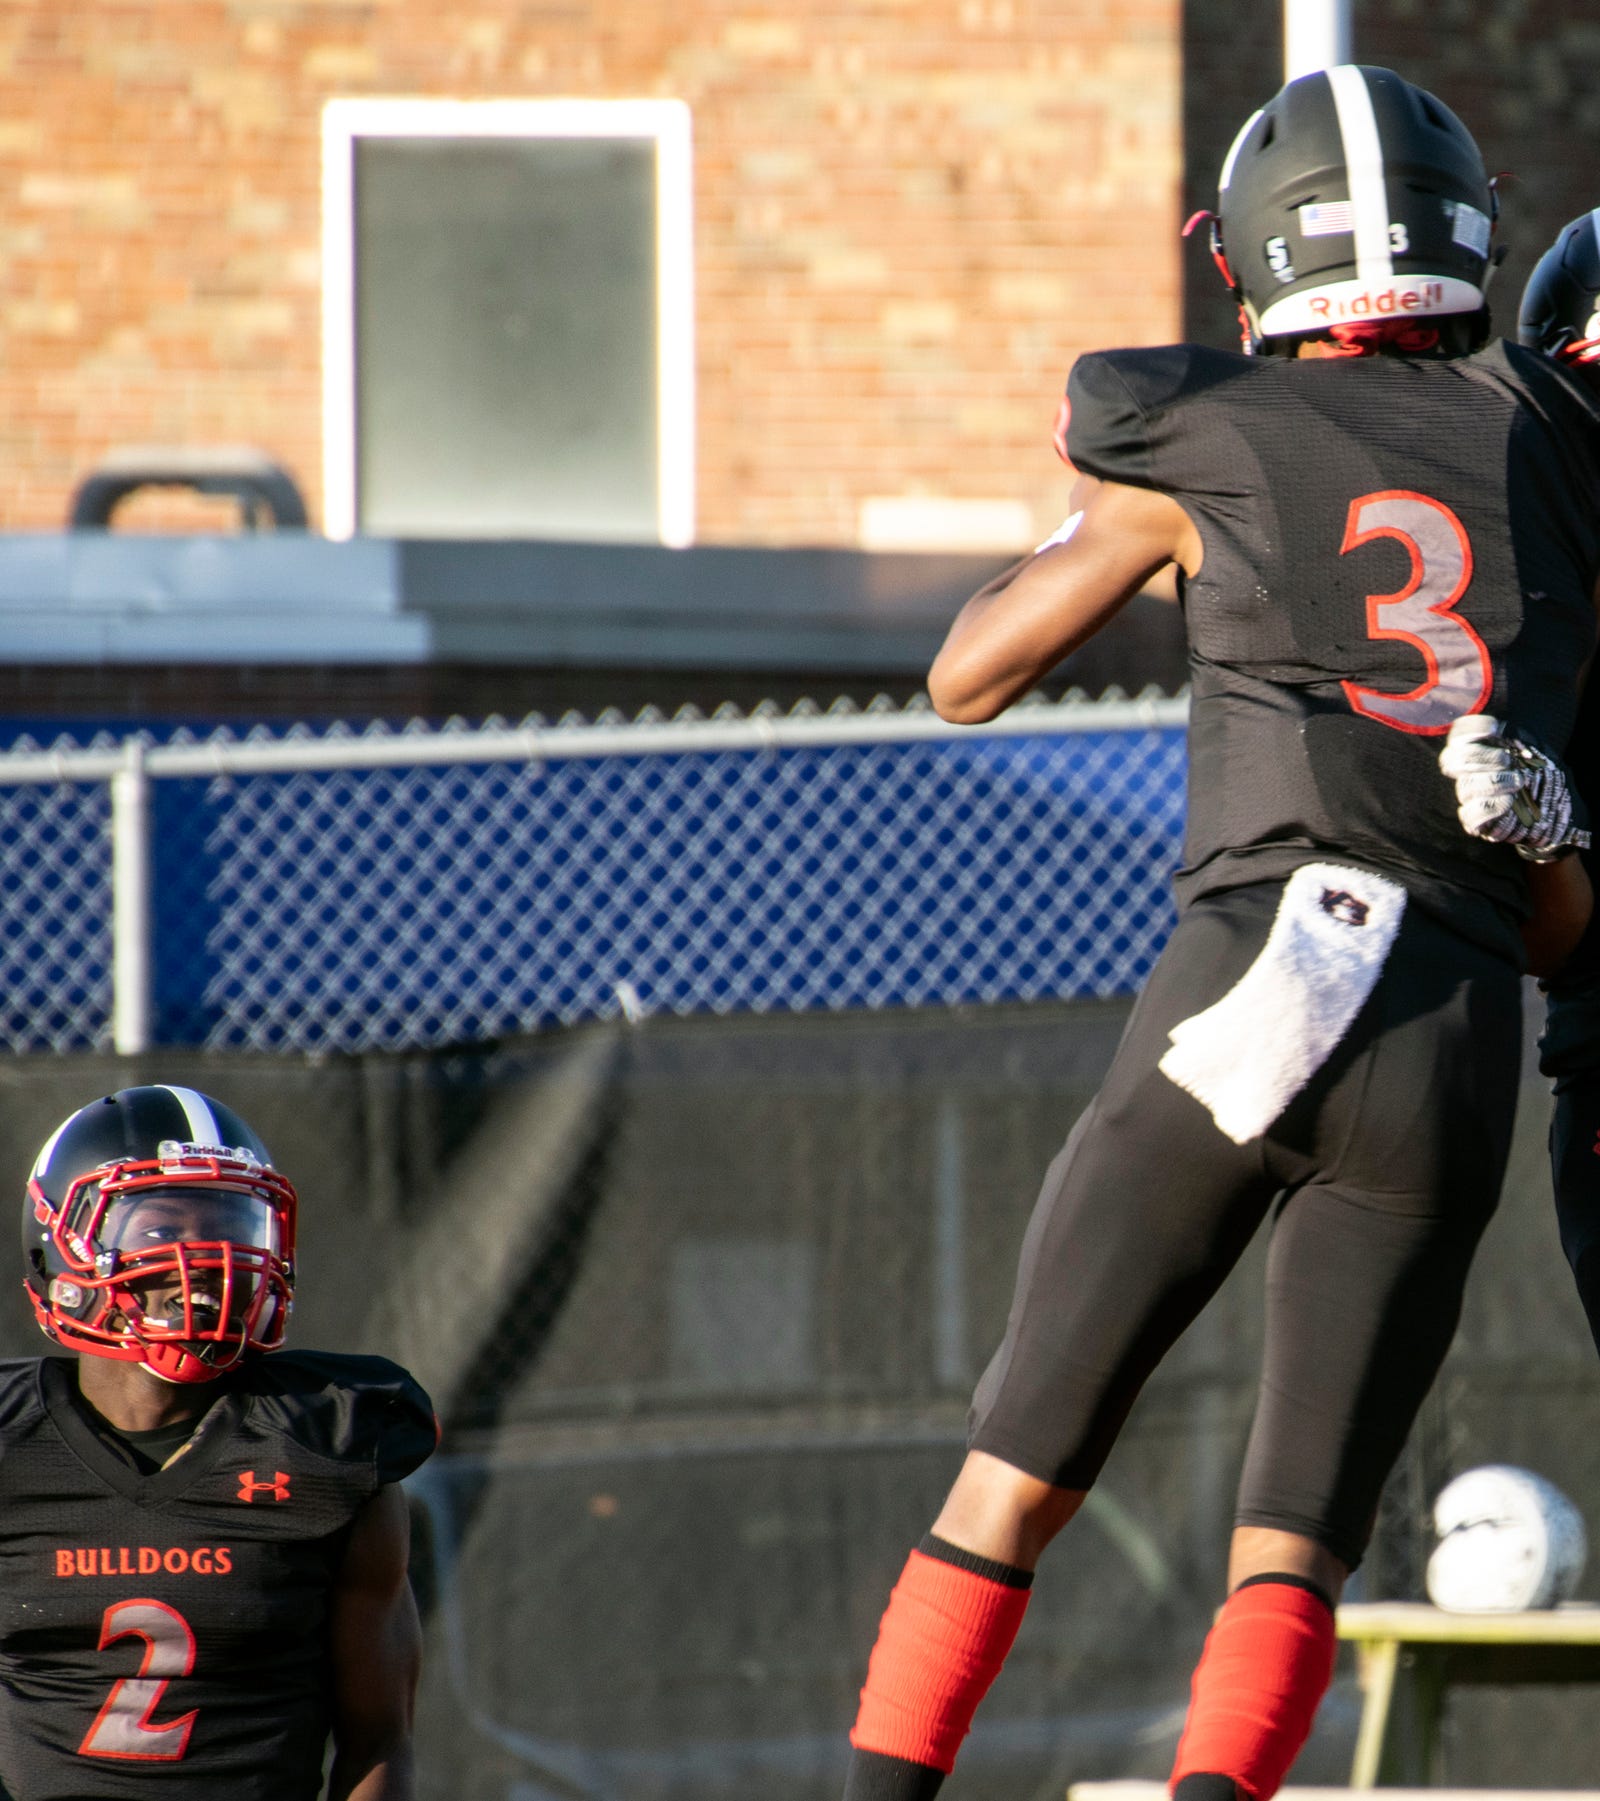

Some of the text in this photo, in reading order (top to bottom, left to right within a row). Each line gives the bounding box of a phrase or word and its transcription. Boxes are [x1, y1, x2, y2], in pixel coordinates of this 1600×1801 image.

[1387, 222, 1409, 253] 3
[1308, 282, 1444, 318] Riddell
[1339, 489, 1493, 737] 3
[56, 1547, 233, 1577] BULLDOGS
[77, 1597, 200, 1761] 2
